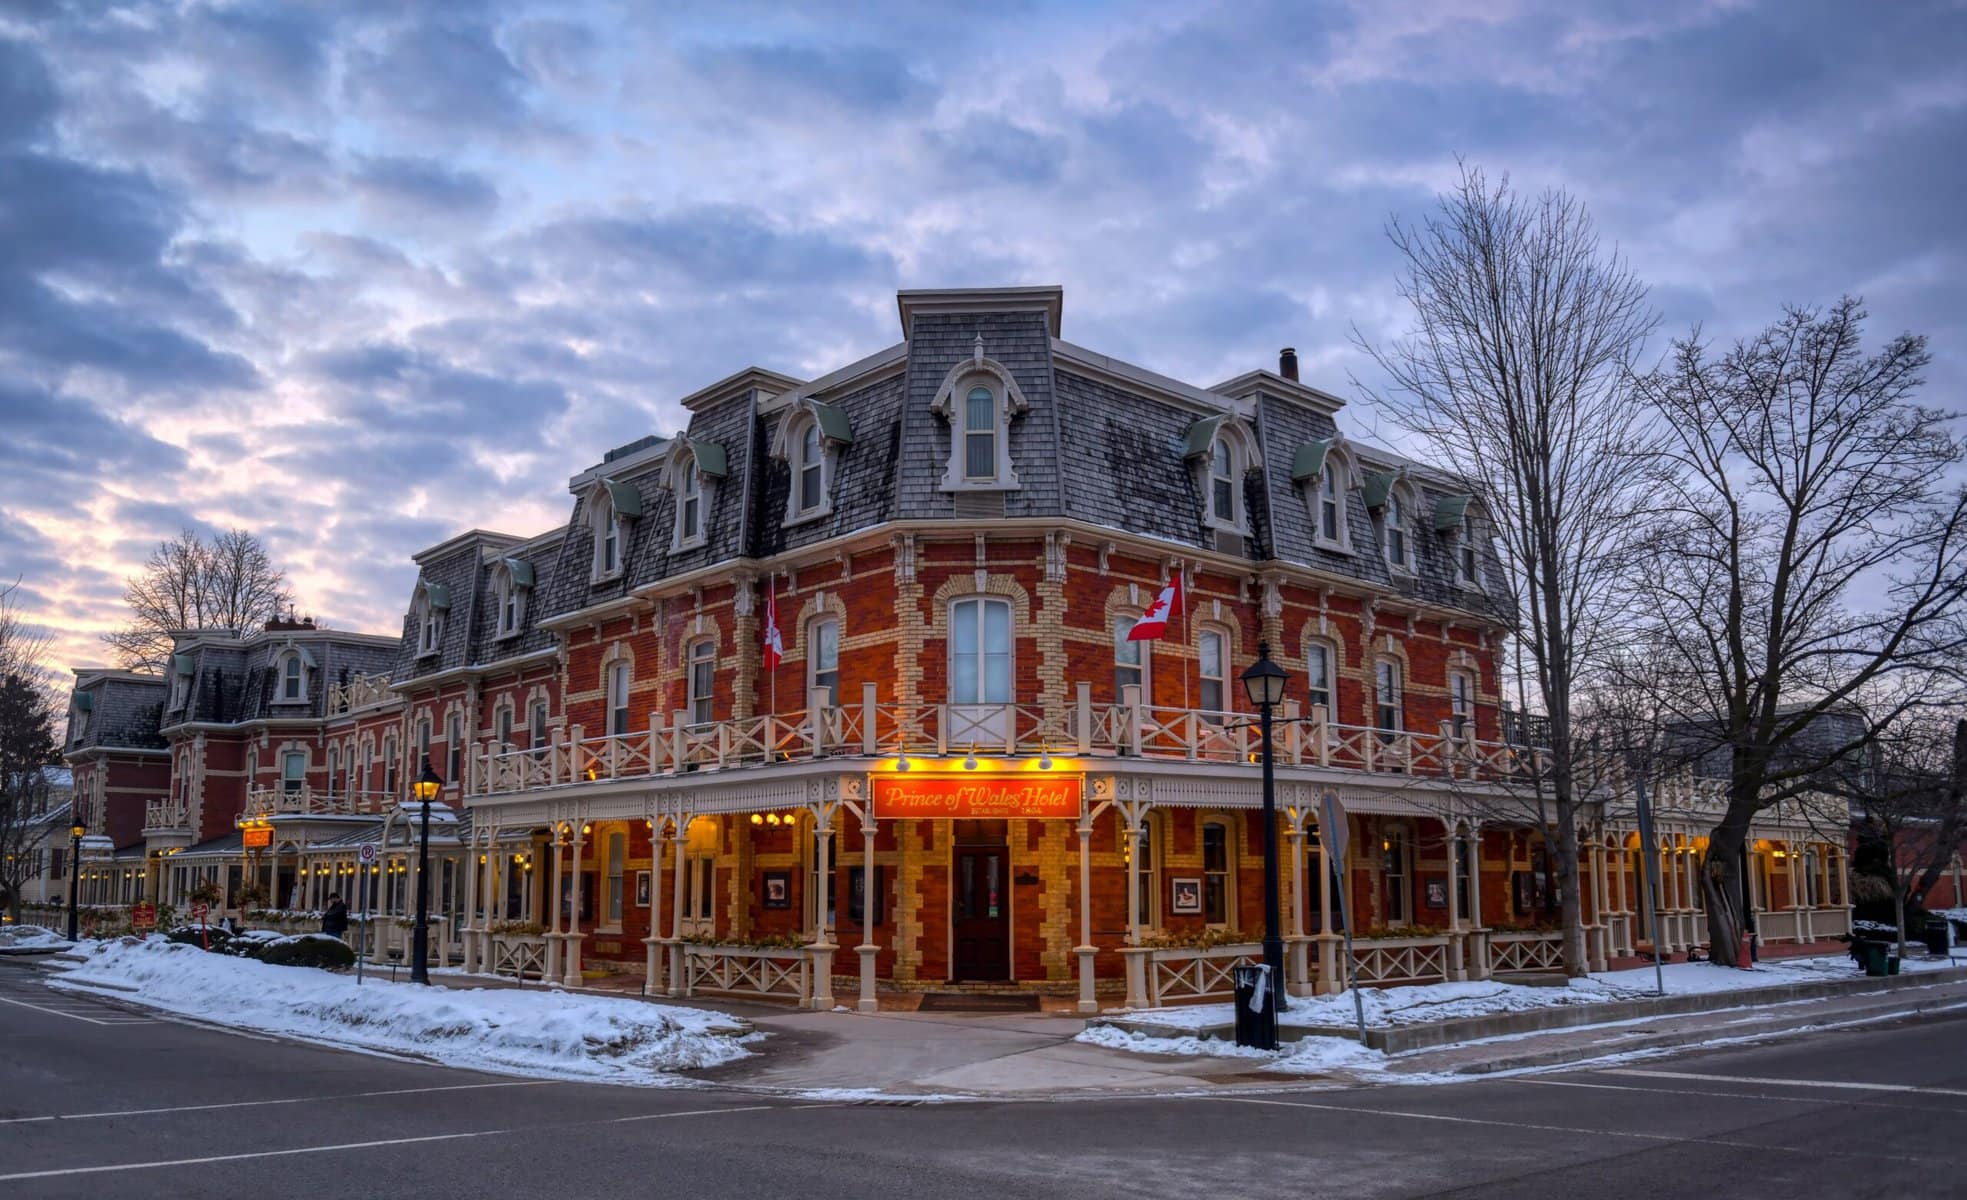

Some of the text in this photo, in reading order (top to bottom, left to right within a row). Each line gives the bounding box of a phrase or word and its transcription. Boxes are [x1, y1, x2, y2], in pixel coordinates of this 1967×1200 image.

[886, 787, 1069, 811] Prince of Wales Hotel
